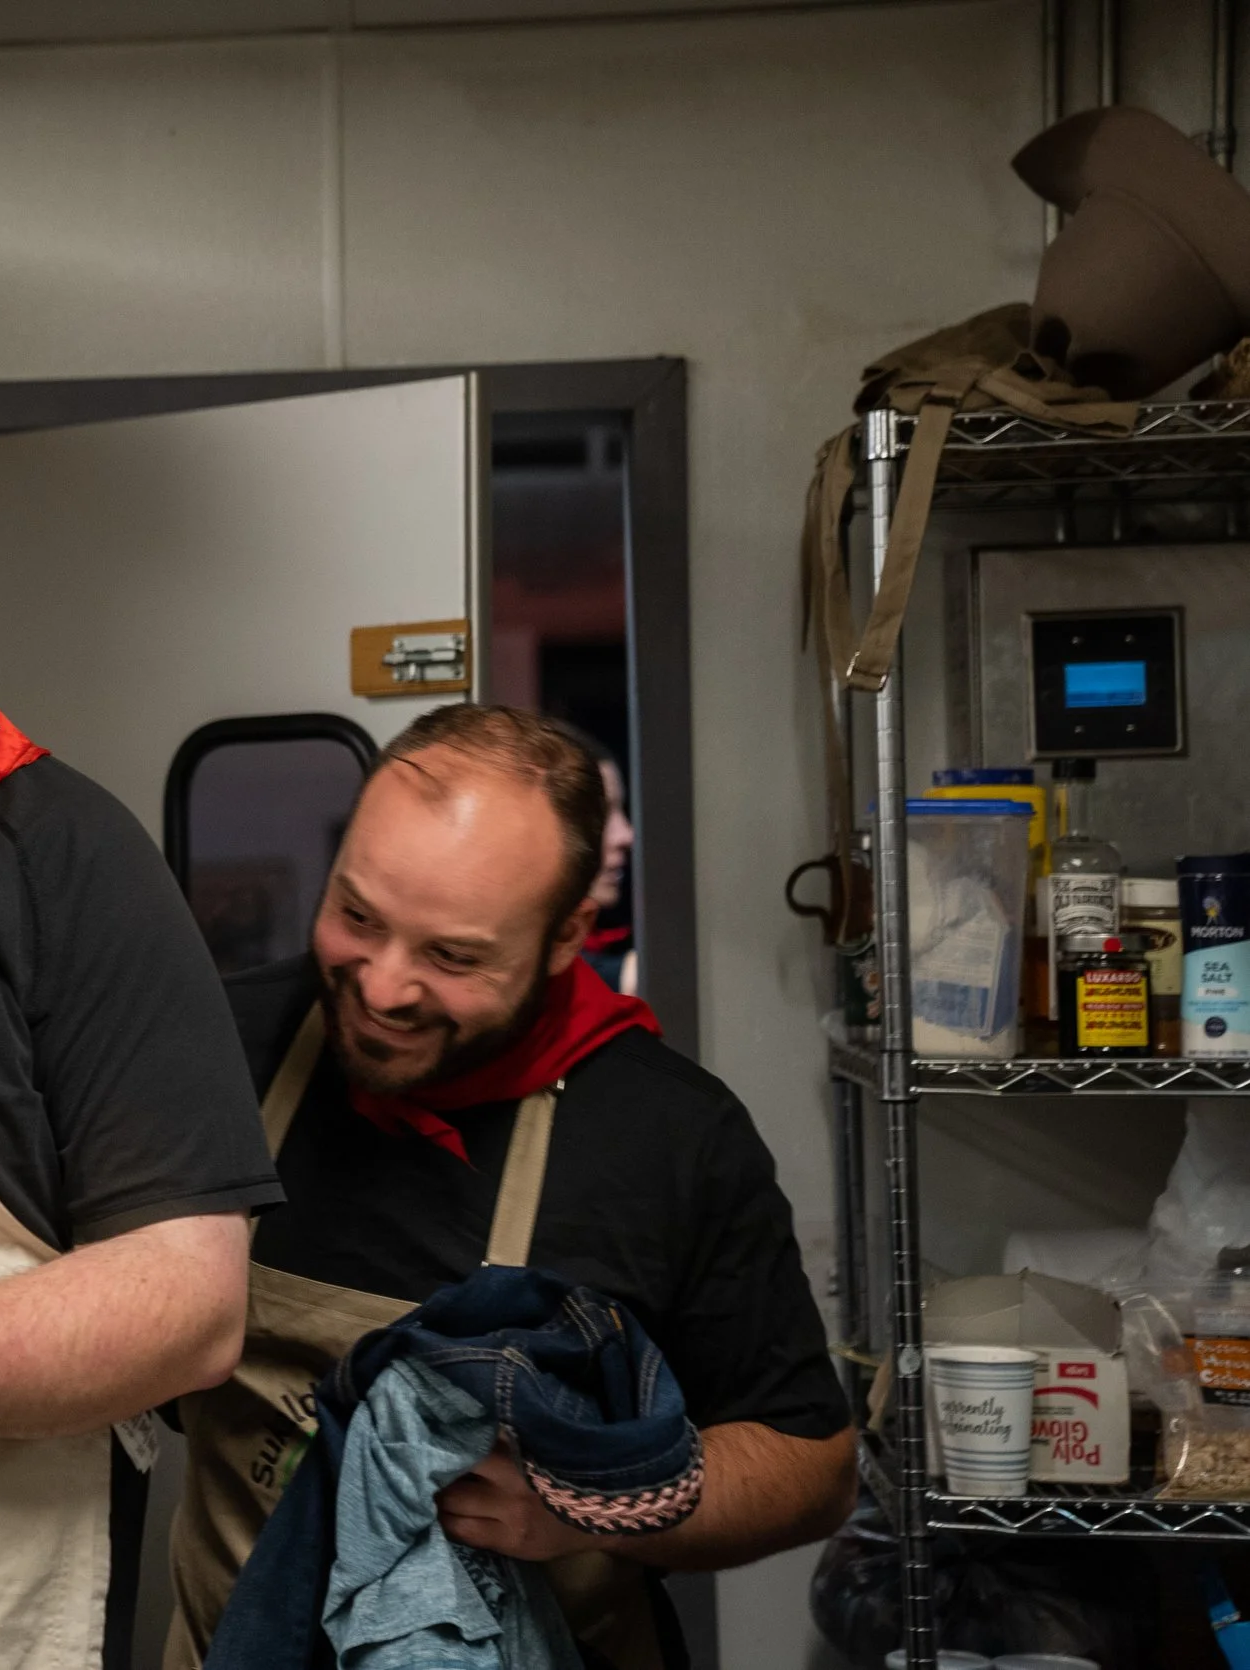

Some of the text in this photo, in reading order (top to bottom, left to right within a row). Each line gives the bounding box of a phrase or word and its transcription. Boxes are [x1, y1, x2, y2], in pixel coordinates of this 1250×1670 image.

[1190, 926, 1244, 937] MORTON
[1203, 961, 1230, 971] SEA
[1200, 972, 1232, 983] SALT
[1051, 1439, 1102, 1467] Poly
